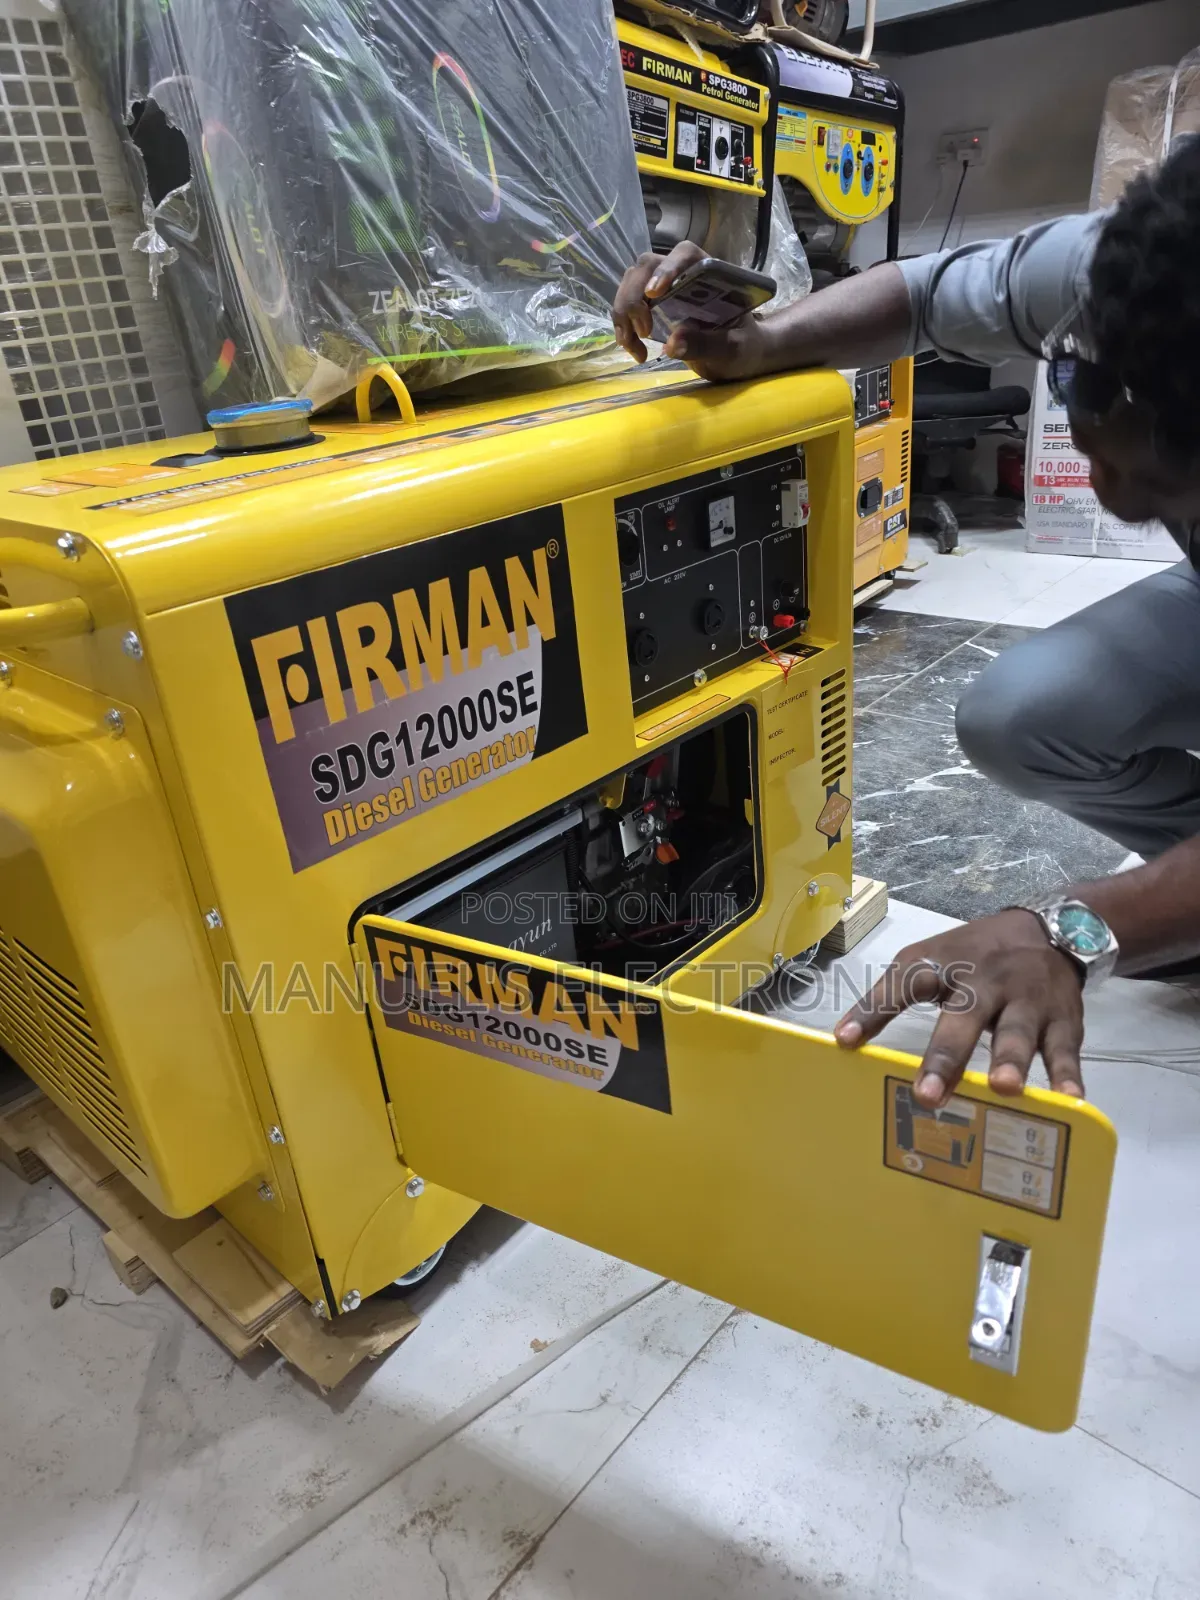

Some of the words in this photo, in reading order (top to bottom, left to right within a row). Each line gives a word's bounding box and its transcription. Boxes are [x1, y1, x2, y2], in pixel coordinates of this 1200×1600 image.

[642, 56, 692, 85] FIRMAN
[702, 83, 724, 99] Petrol
[725, 89, 759, 110] Generator
[708, 74, 748, 96] SPG3800
[627, 90, 655, 105] SPG3800
[1039, 461, 1080, 474] 10,000
[1043, 475, 1056, 485] 13
[1034, 495, 1046, 504] 18
[1048, 495, 1064, 504] HP
[887, 512, 902, 532] CAT
[310, 670, 539, 804] SDG12000SE
[322, 775, 415, 847] Diesel
[417, 723, 538, 803] Generator
[401, 992, 610, 1068] SDG12000SE
[407, 1010, 477, 1044] Diesel
[480, 1030, 606, 1083] Generator
